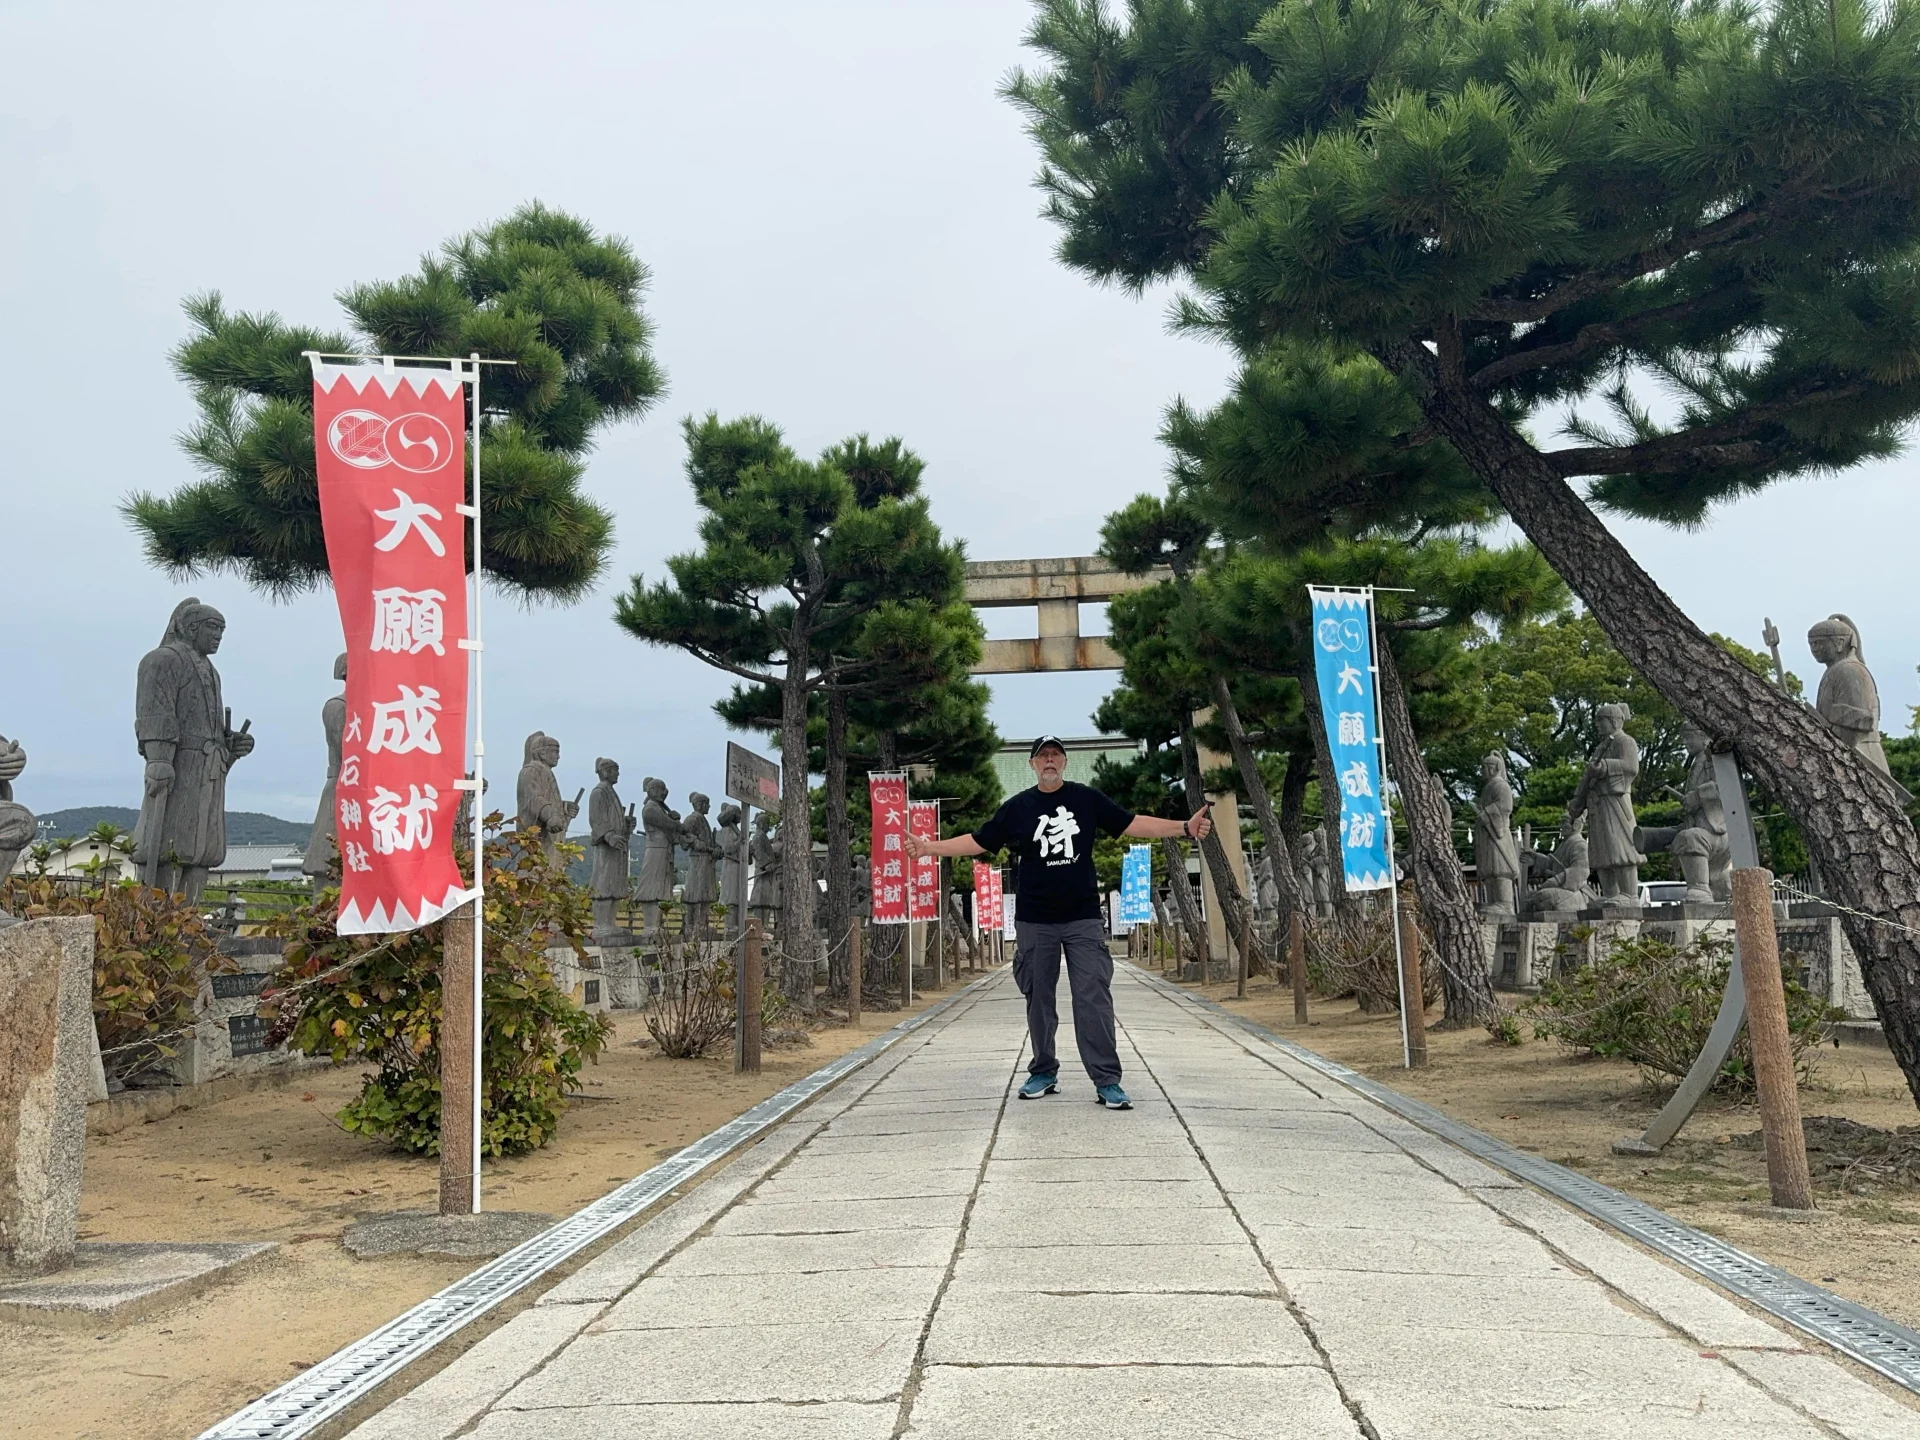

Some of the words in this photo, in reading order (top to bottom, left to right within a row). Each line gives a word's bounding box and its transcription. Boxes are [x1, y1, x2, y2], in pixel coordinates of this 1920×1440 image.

[366, 487, 447, 856] 大願成就
[340, 711, 373, 873] 大石神社
[1337, 659, 1377, 848] 大願成就
[883, 808, 903, 903] 大願成就
[1032, 804, 1081, 859] 侍
[1046, 858, 1071, 867] SAMURAI
[874, 866, 883, 909] 大石神社
